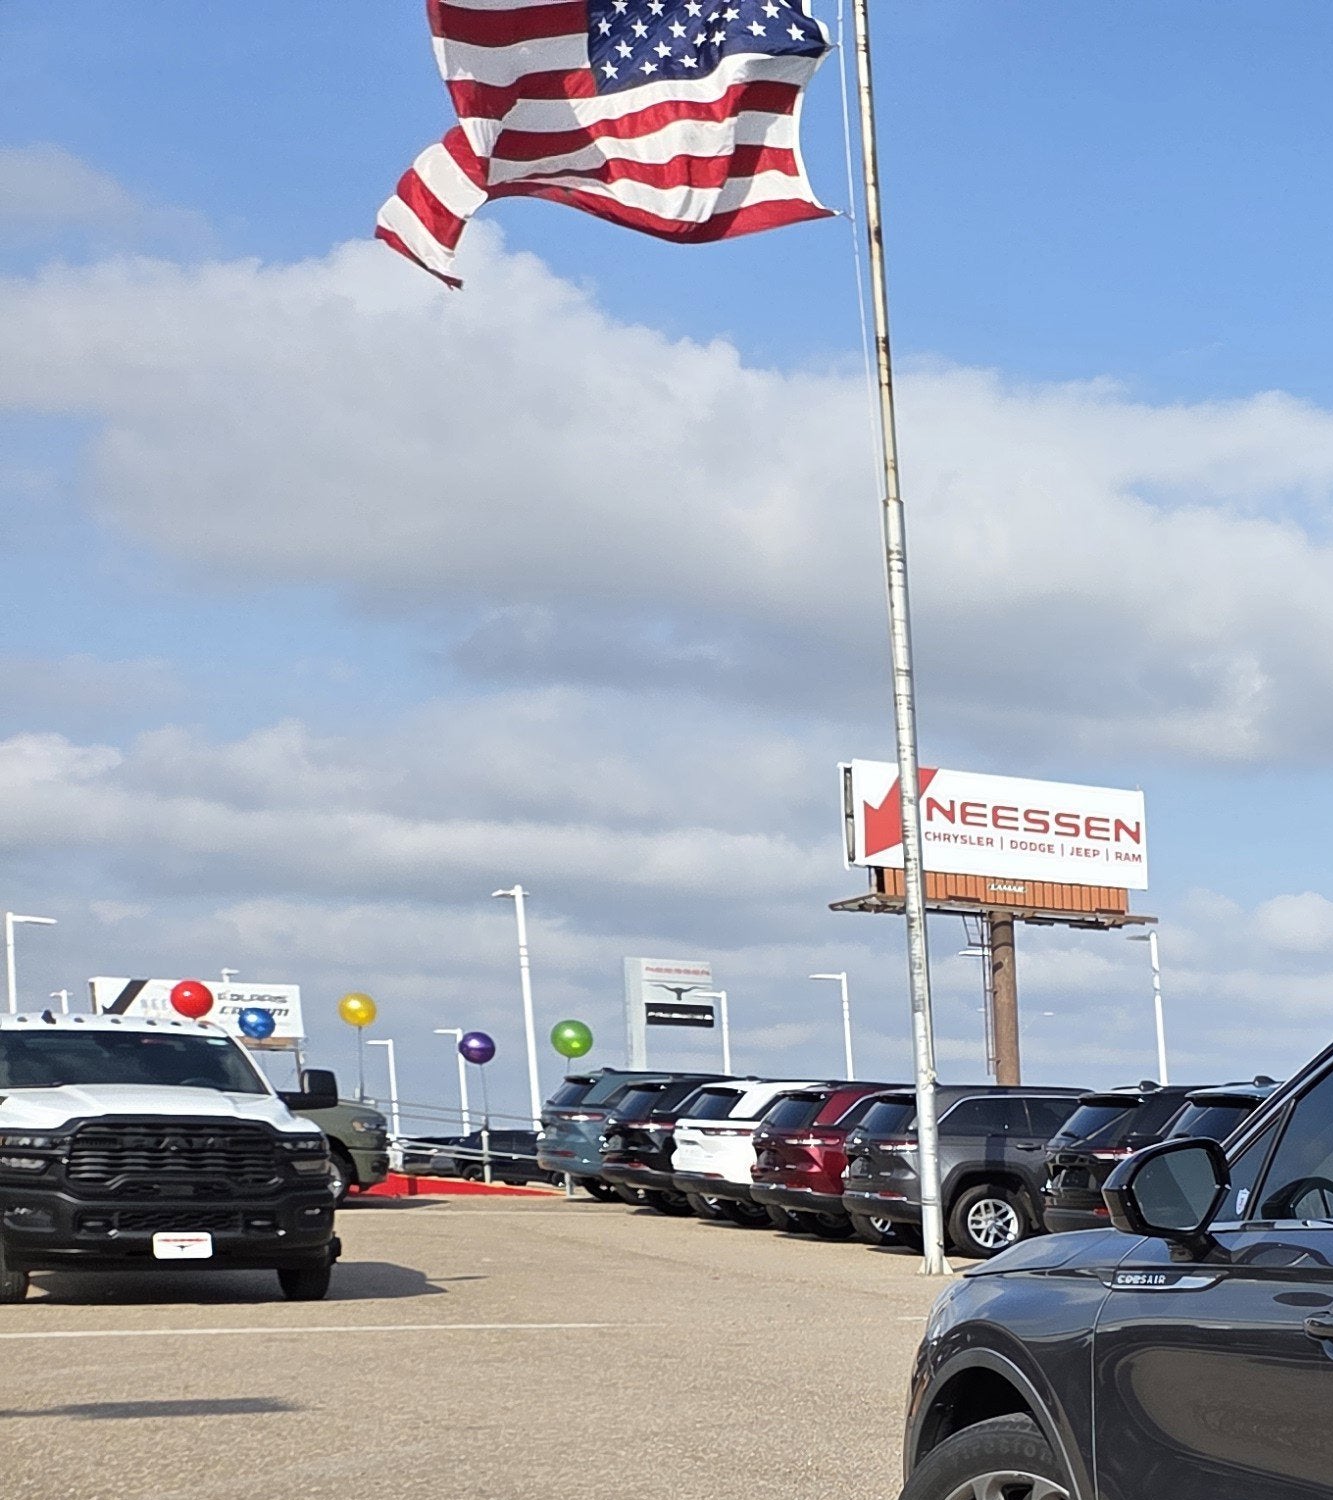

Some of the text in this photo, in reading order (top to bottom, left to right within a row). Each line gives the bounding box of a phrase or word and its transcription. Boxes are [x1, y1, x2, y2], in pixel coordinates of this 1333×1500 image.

[926, 797, 1140, 844] NEESSEN
[924, 831, 1142, 863] CHRYSLER DODGE JEEP RAM
[1117, 1275, 1166, 1284] CORSAIR
